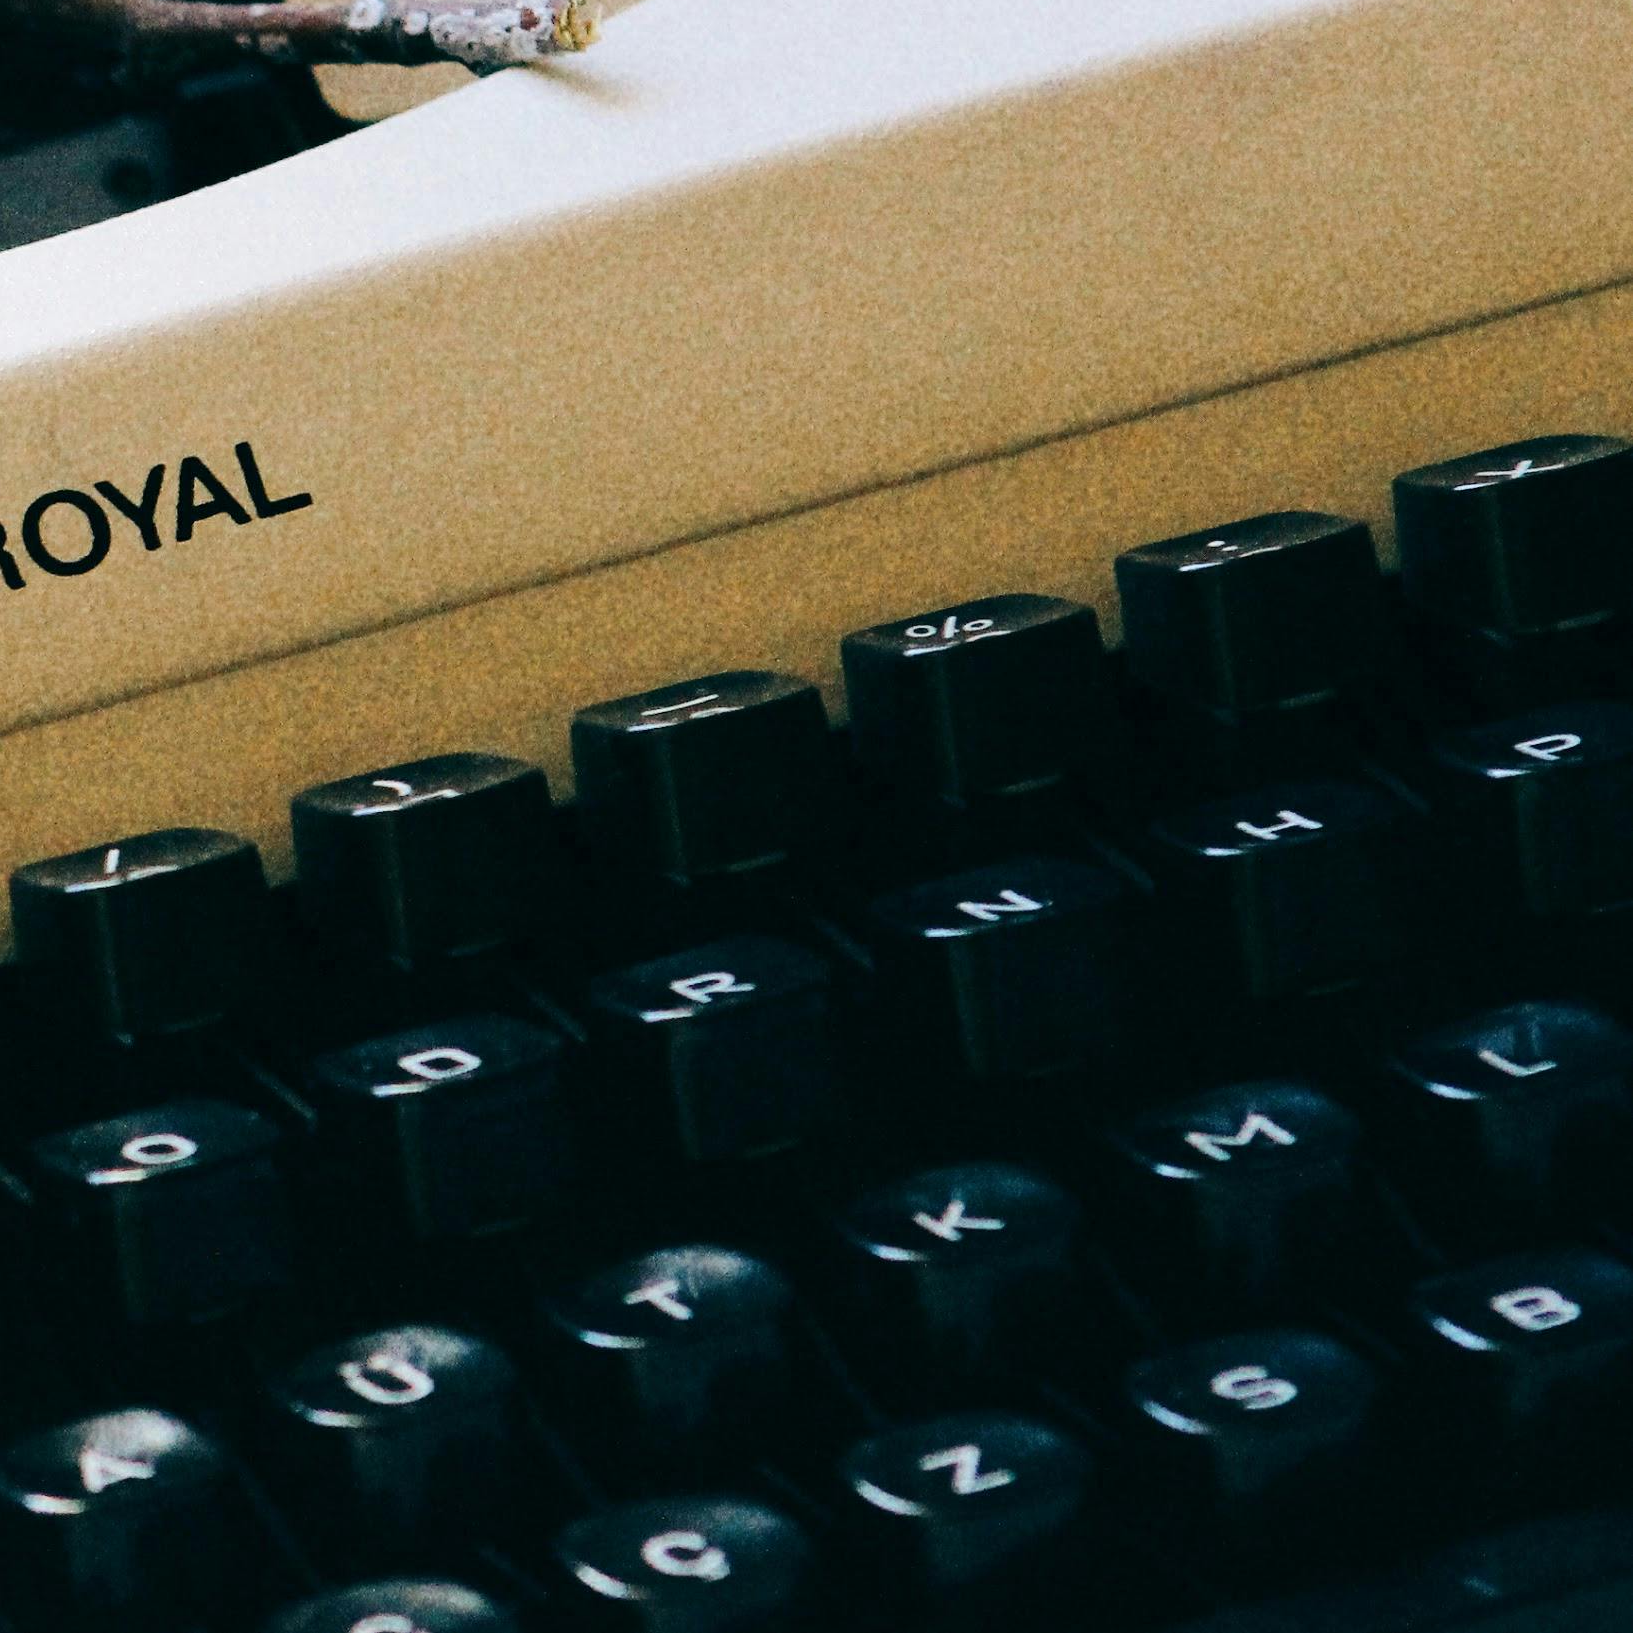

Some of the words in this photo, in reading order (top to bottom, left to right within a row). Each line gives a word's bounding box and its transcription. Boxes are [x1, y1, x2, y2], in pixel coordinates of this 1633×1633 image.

[1514, 733, 1581, 761] P
[1236, 810, 1323, 840] H
[957, 889, 1043, 921] N
[670, 972, 754, 1004] R
[1478, 1049, 1557, 1077] L
[1187, 1114, 1295, 1161] M
[914, 1199, 1003, 1241] K
[626, 1278, 690, 1319] T
[1493, 1287, 1580, 1330] B
[1212, 1366, 1297, 1410] S
[923, 1445, 1011, 1494] Z
